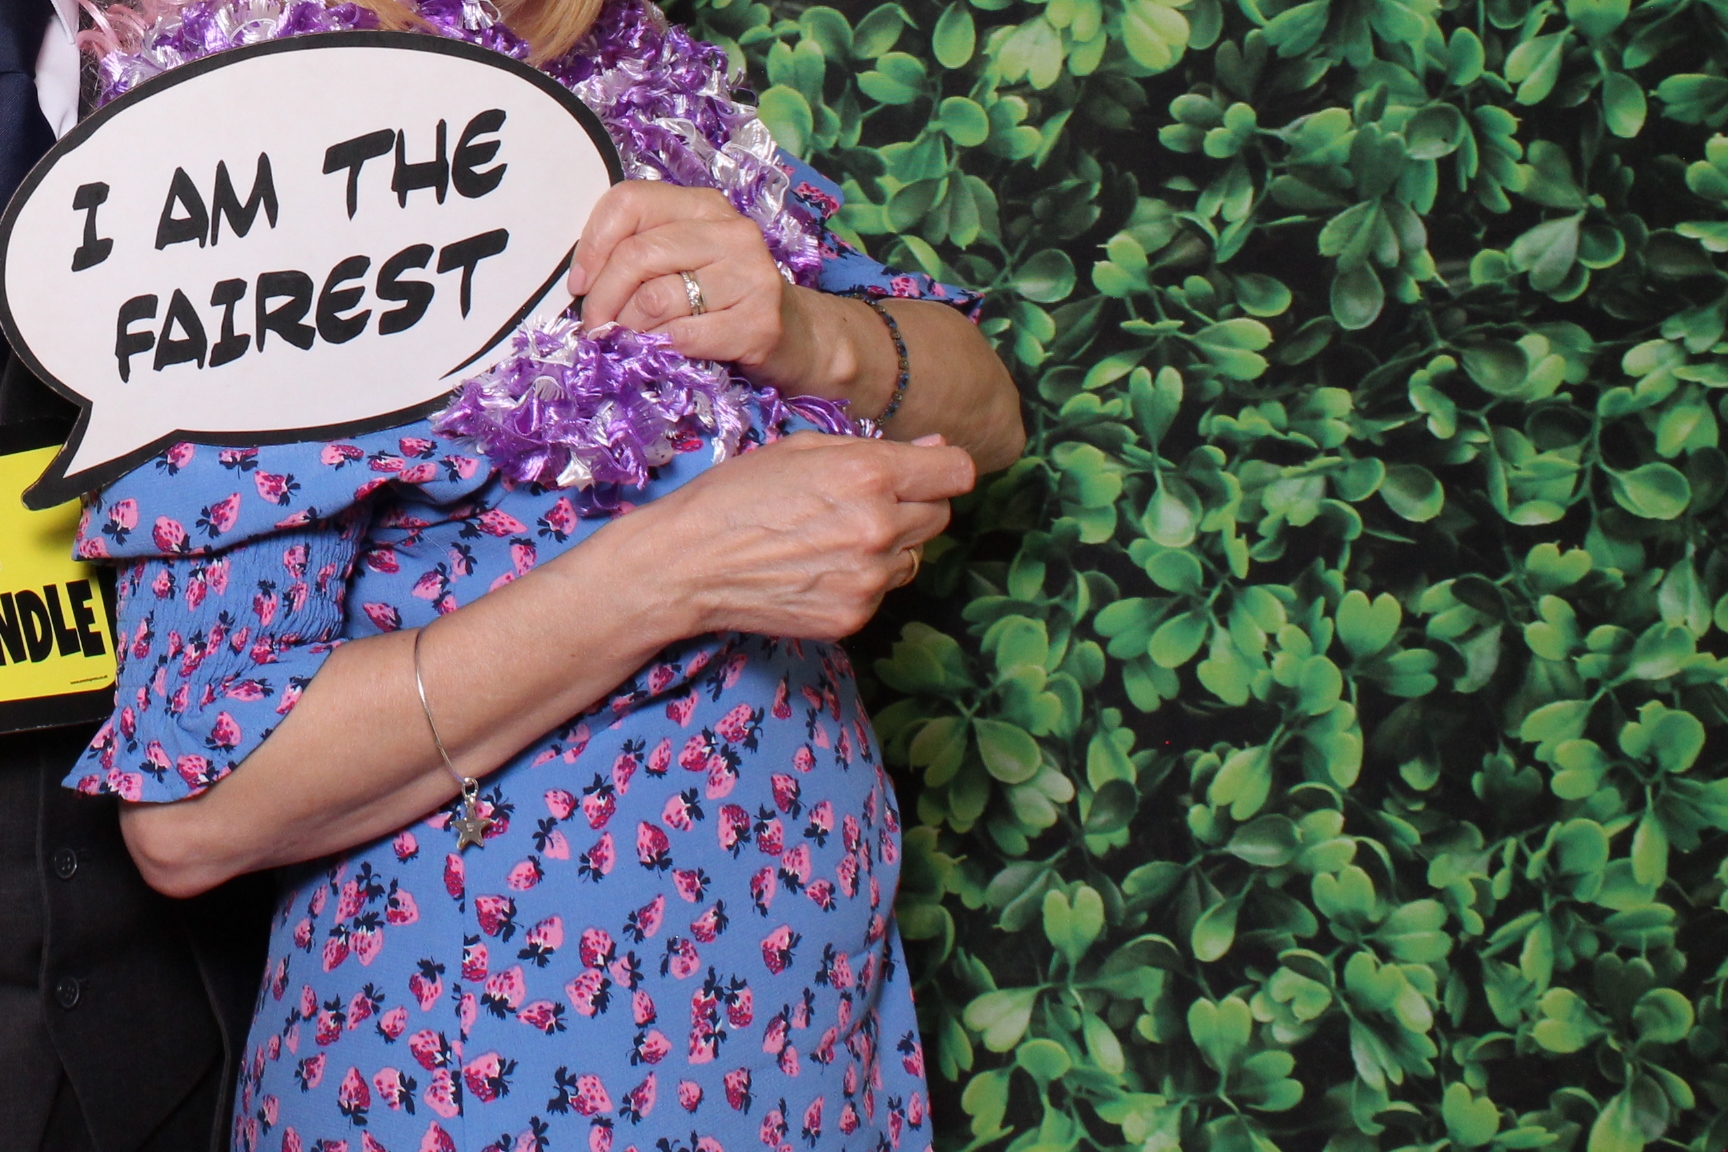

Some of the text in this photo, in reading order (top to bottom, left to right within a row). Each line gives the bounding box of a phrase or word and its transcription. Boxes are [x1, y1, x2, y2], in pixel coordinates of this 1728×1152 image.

[71, 108, 508, 272] I AM THE
[114, 228, 510, 384] FAIREST
